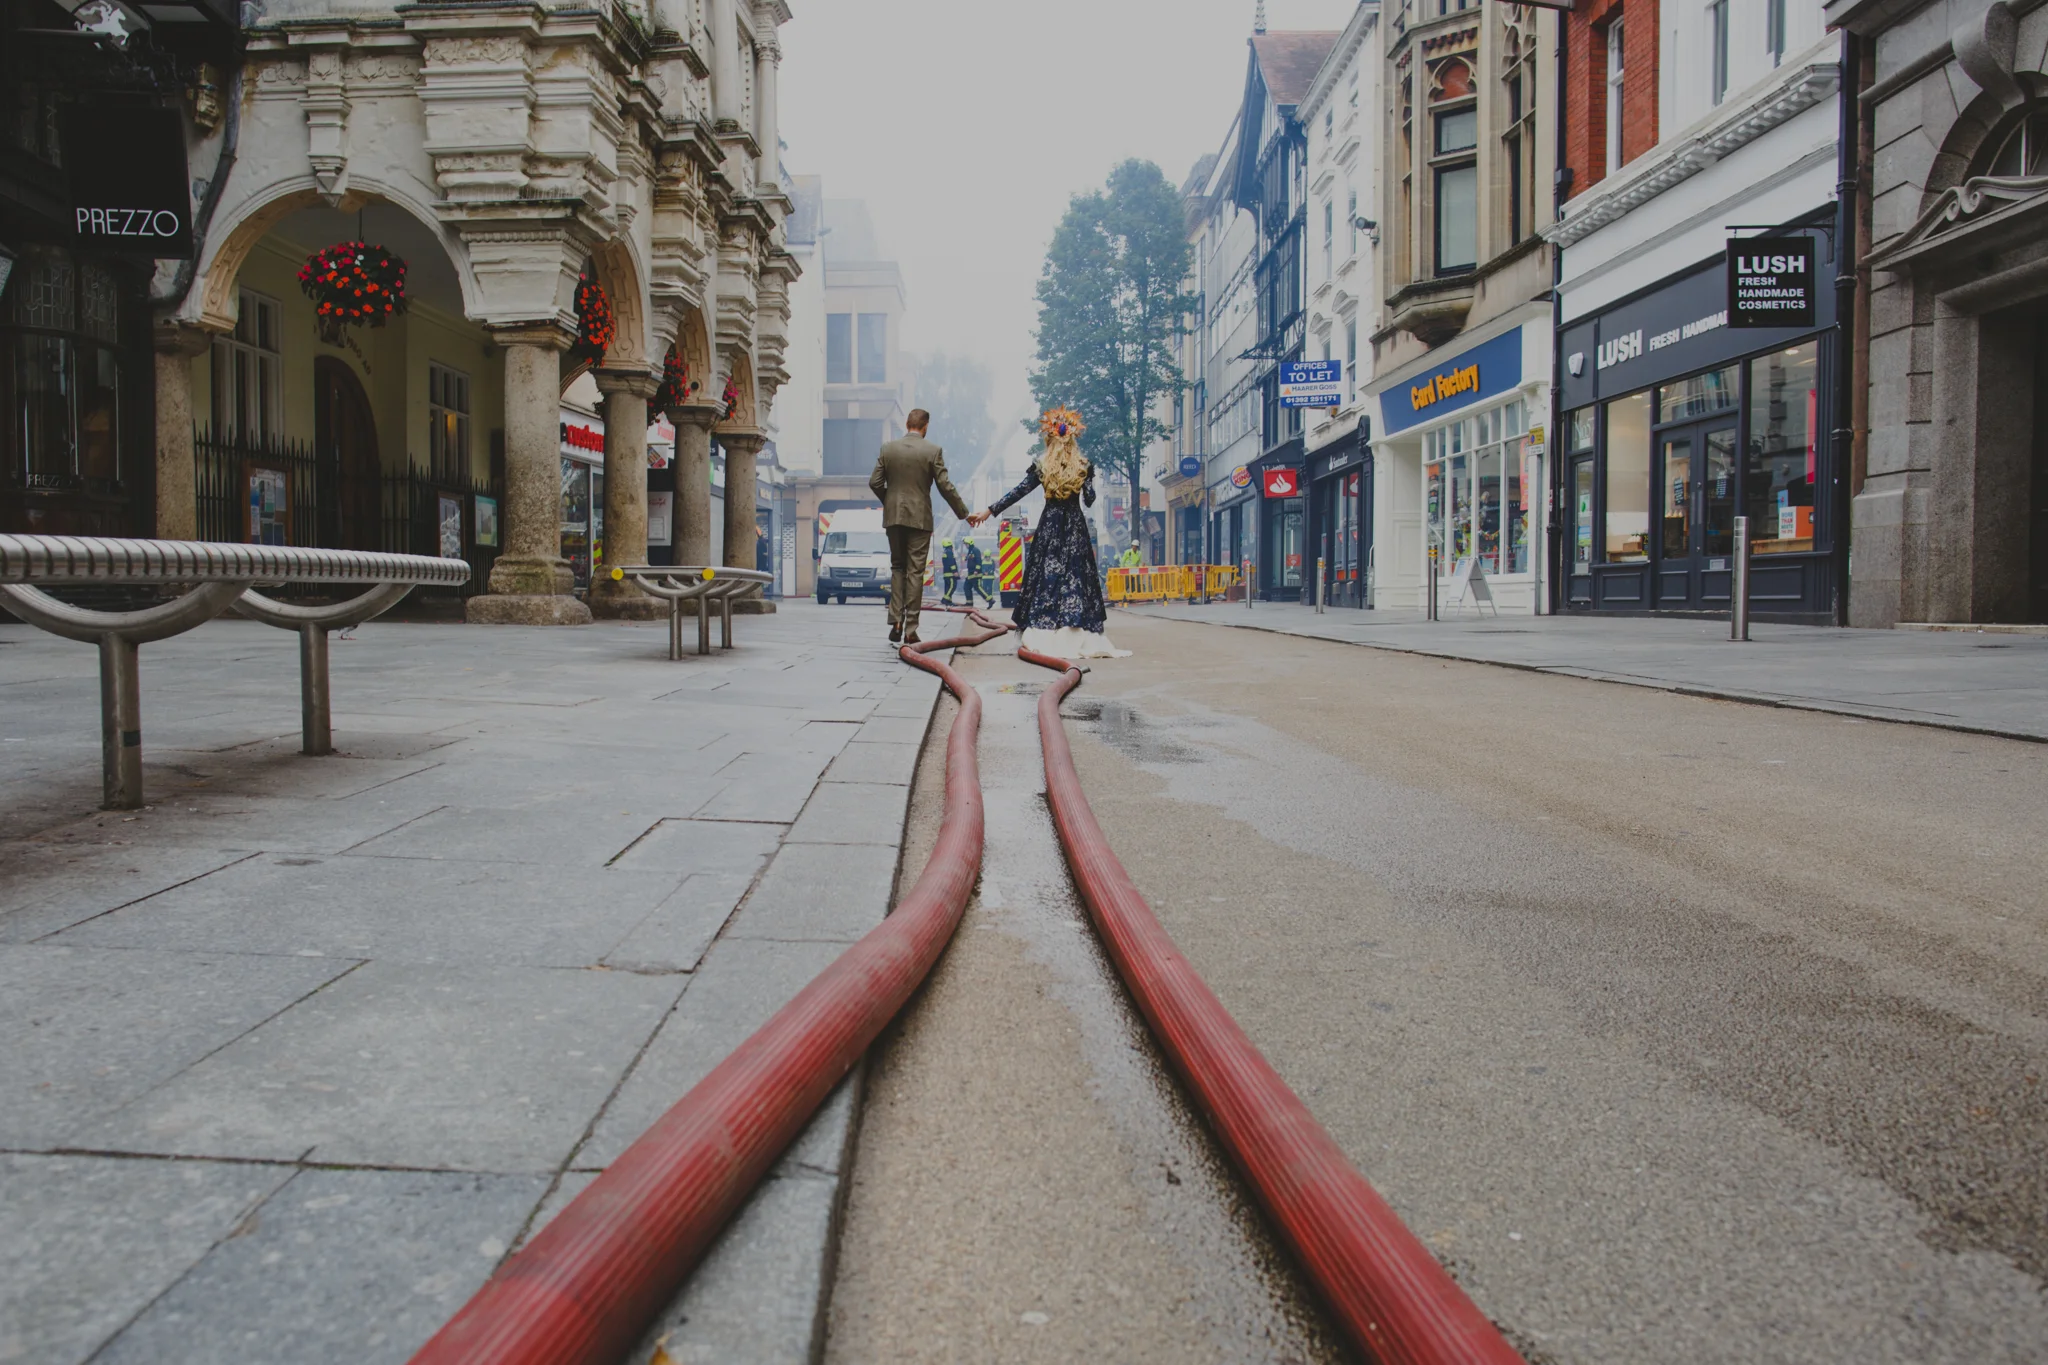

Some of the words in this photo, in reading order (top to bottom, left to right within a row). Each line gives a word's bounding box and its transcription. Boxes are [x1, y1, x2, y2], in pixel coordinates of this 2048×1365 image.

[76, 207, 179, 237] PREZZO
[1737, 255, 1805, 274] LUSH
[1738, 277, 1776, 286] FRESH
[1738, 288, 1804, 298] HANDMADE
[1738, 300, 1806, 310] COSMETICS
[1598, 329, 1642, 370] LUSH
[1650, 328, 1680, 351] FRESH
[1293, 361, 1328, 371] OFFICES
[1288, 372, 1307, 382] TO
[1310, 370, 1333, 381] LET
[1411, 379, 1437, 411] Card
[1436, 364, 1479, 401] Factory
[1286, 396, 1309, 404] 01392
